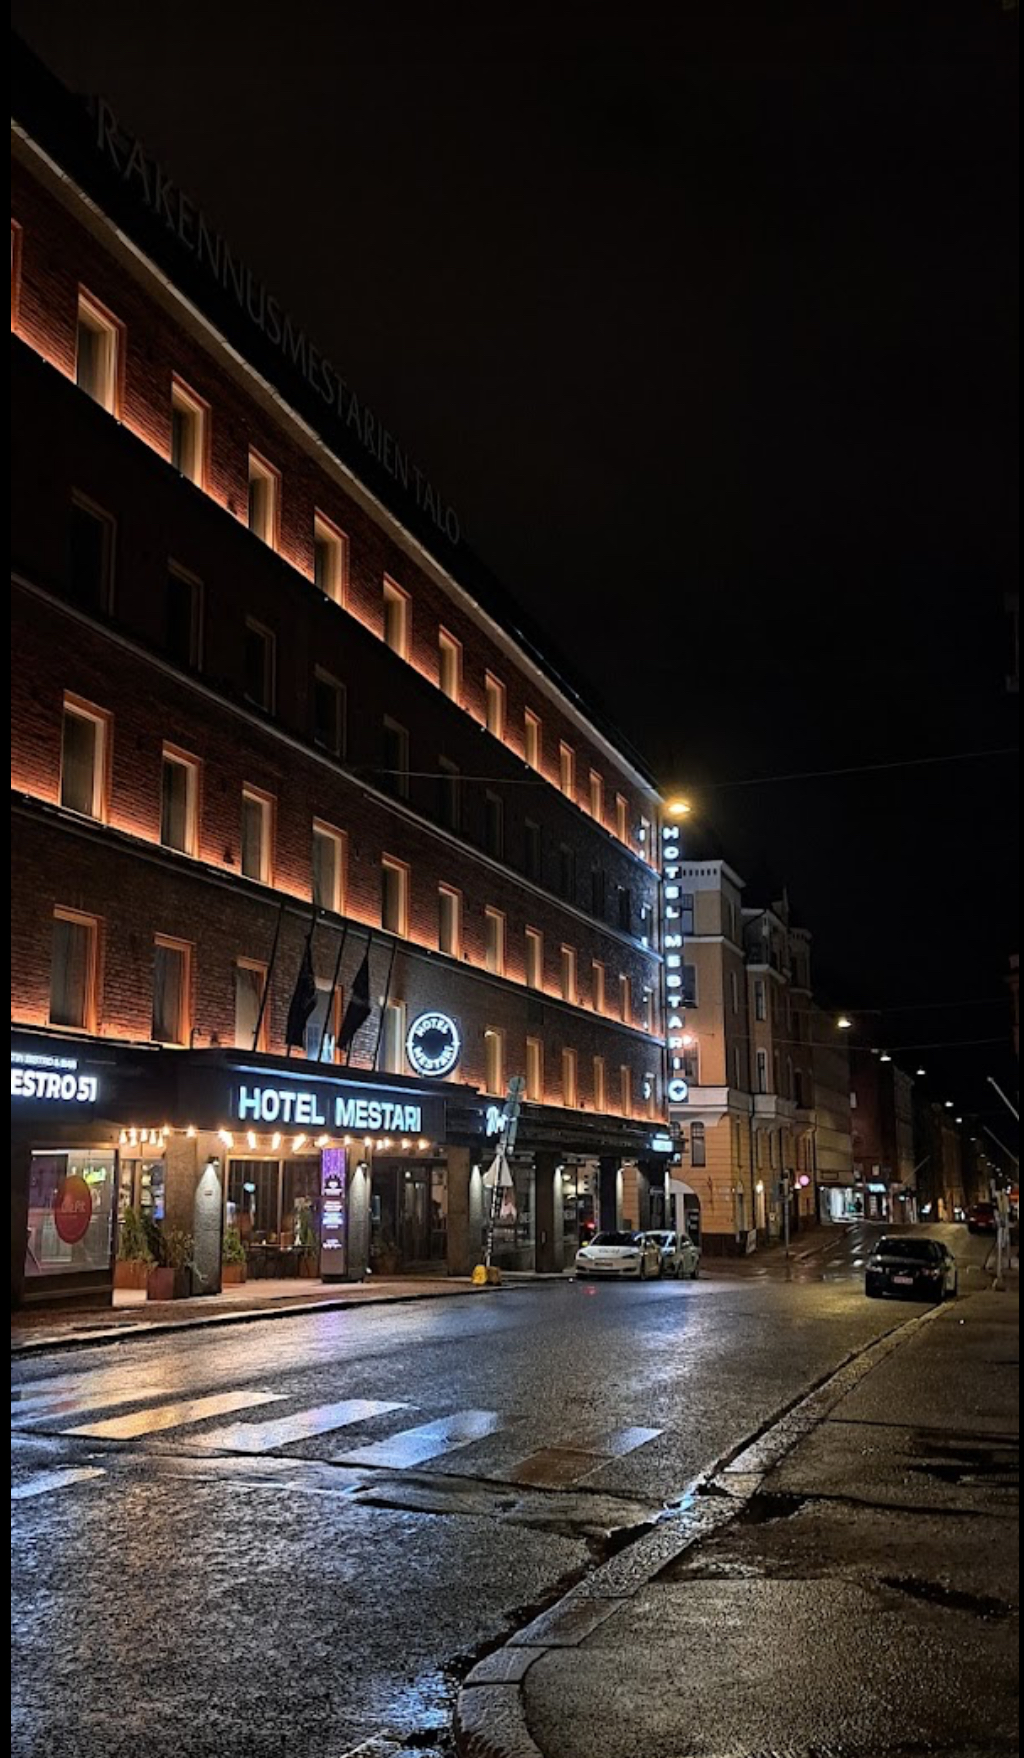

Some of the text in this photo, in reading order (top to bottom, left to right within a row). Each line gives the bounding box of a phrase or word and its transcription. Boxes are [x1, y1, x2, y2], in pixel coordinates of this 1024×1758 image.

[663, 826, 680, 919] HOTEL
[665, 934, 682, 1070] MESTARI
[415, 1018, 450, 1037] HOTEL
[413, 1045, 454, 1069] MESTARI
[238, 1085, 422, 1132] HOTEL MESTARI
